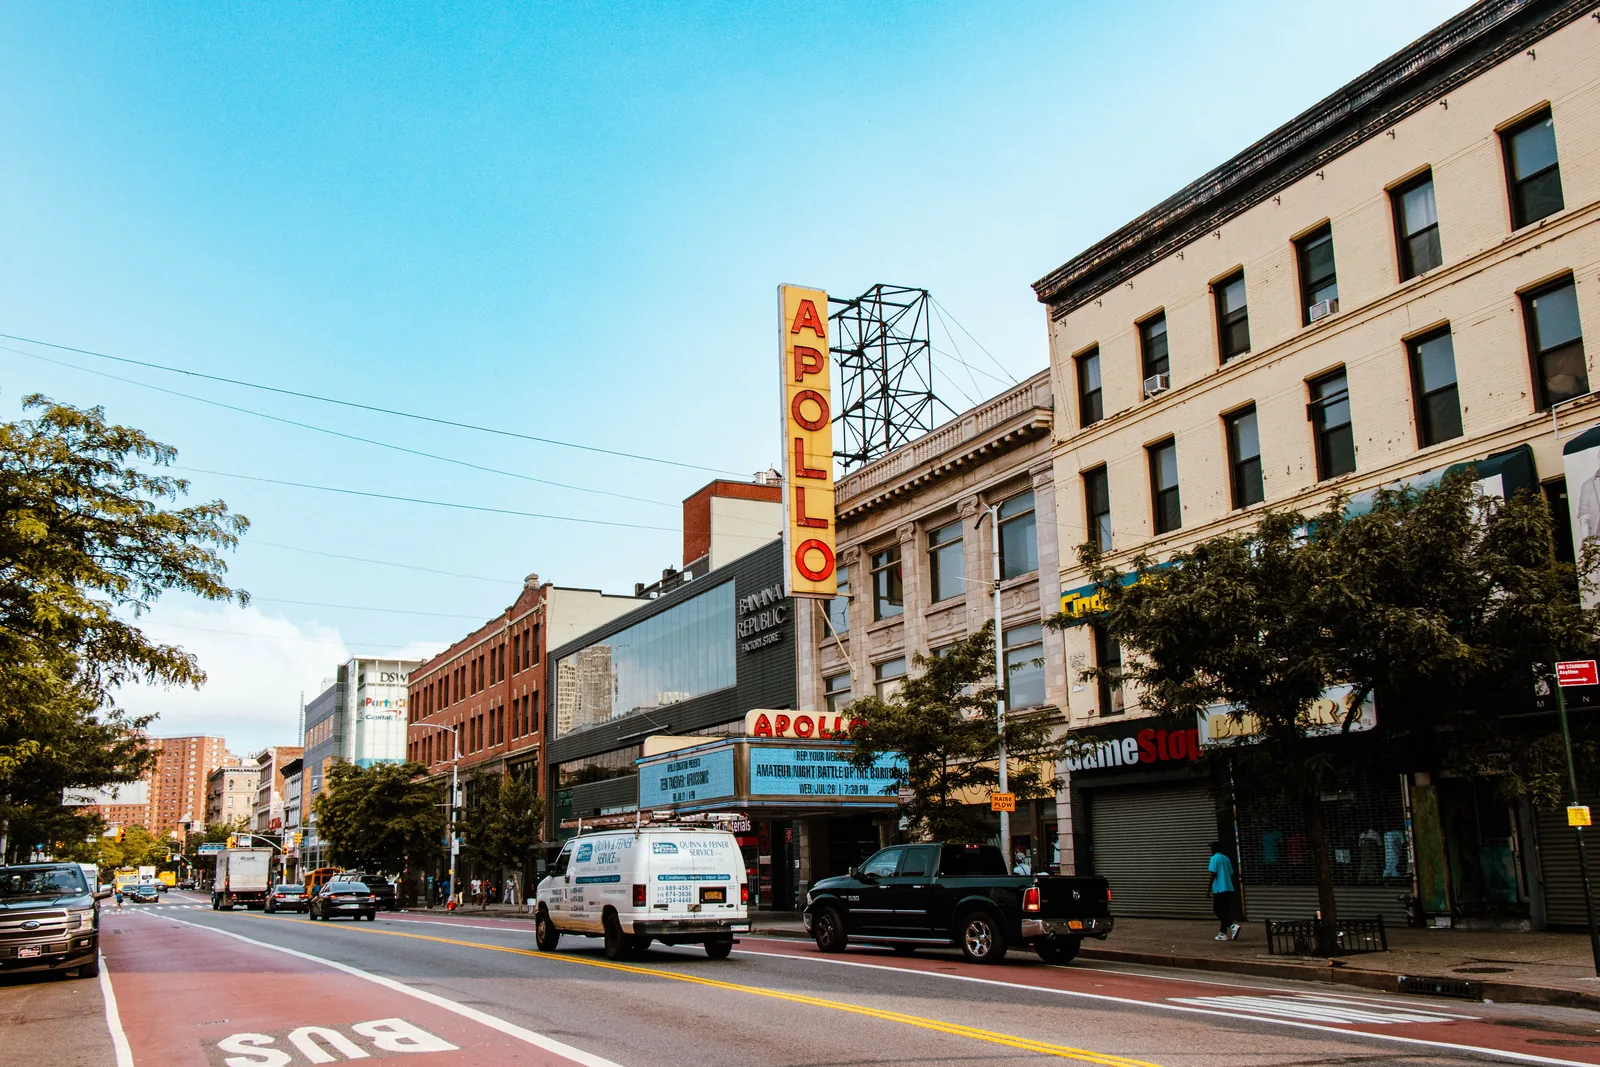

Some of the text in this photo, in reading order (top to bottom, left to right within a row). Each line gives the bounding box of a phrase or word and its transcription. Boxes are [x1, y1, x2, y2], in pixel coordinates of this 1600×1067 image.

[791, 298, 835, 582] APOLLO
[739, 583, 784, 615] BANANA
[736, 605, 788, 639] REPUBLIC
[741, 631, 782, 652] FACTORY STORE
[380, 672, 408, 683] DSW
[365, 697, 395, 708] Party
[808, 751, 825, 761] YOUR
[1066, 728, 1200, 772] GameStop
[756, 764, 791, 778] AMATEUR
[793, 764, 815, 778] NIGHT
[818, 765, 843, 779] BATTLE
[844, 766, 854, 779] OF
[855, 766, 869, 779] THE
[814, 784, 826, 795] JUL
[827, 784, 836, 795] 26
[844, 784, 858, 795] 7:30
[859, 784, 868, 795] PM
[722, 819, 751, 832] mterials
[594, 840, 611, 853] QUINN
[679, 840, 702, 849] QUINN
[708, 840, 729, 848] FEINER
[596, 851, 617, 864] SERVICE
[689, 848, 715, 857] SERVICE
[217, 1018, 461, 1067] BUS
